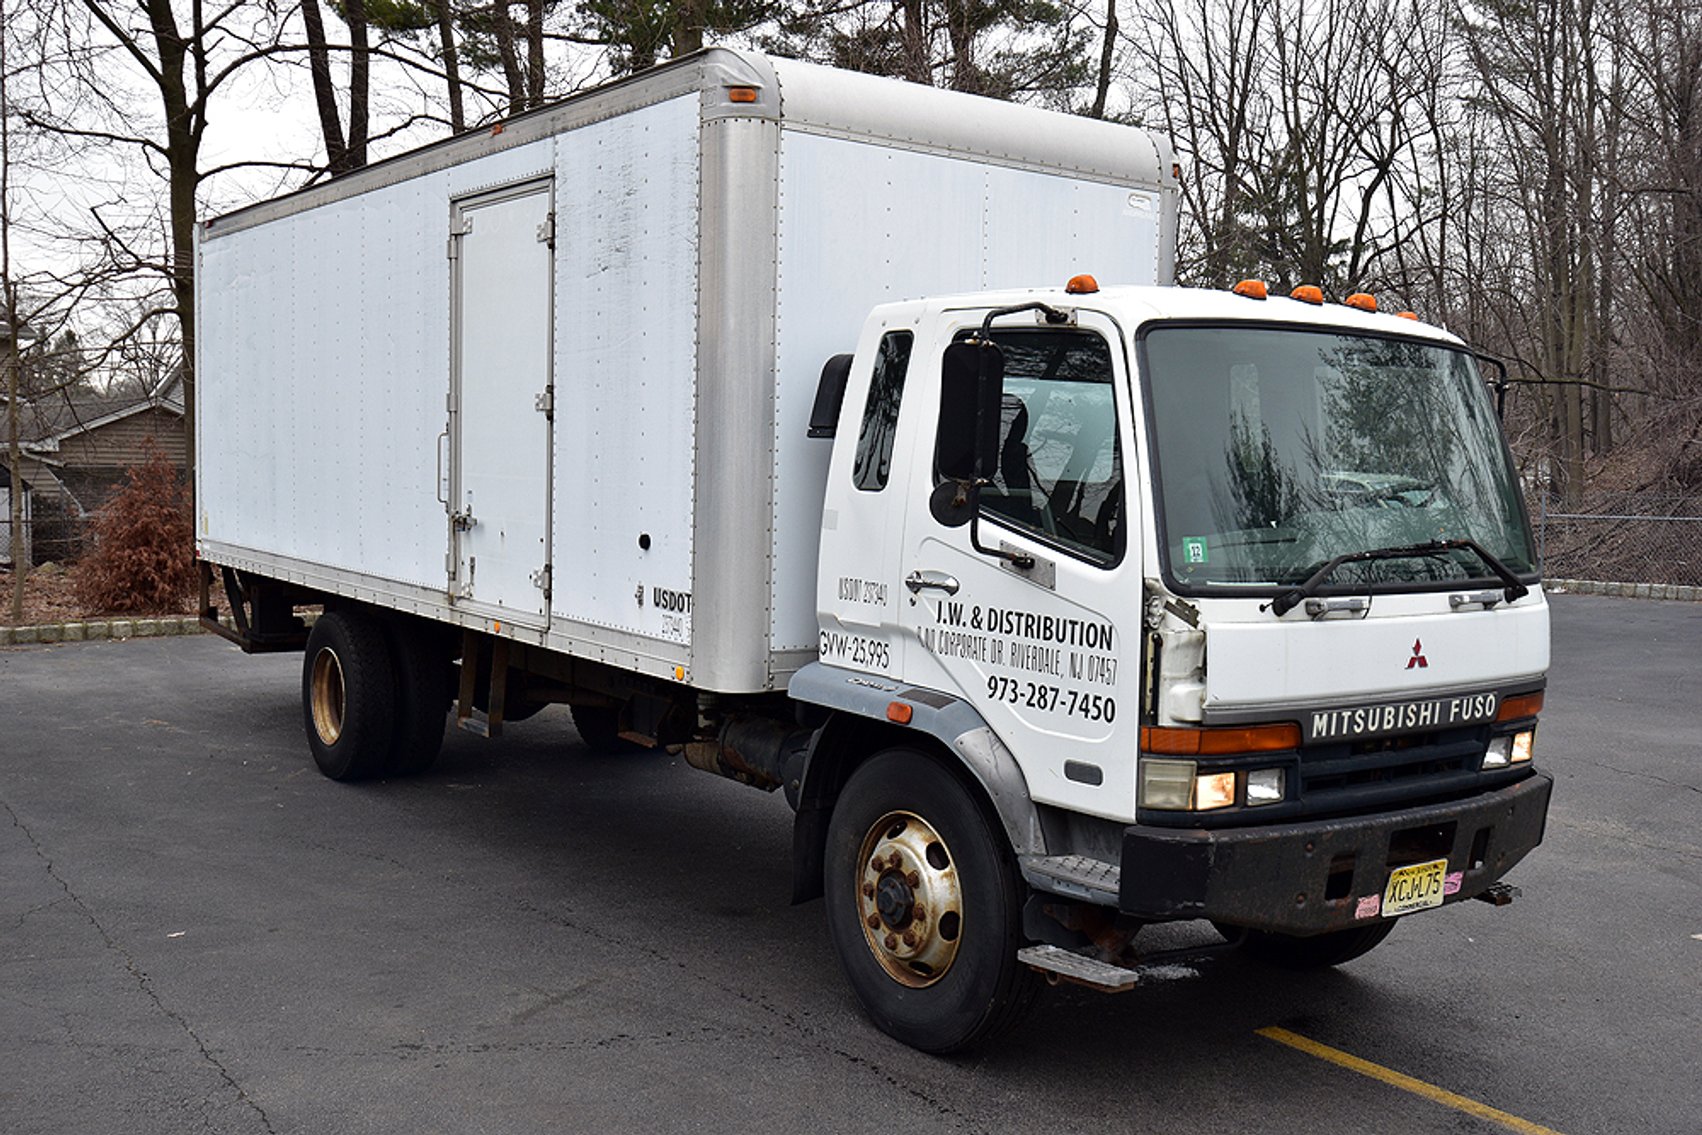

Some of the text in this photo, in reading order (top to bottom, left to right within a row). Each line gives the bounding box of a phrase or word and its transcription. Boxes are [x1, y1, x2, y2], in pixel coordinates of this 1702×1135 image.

[653, 586, 692, 614] USDOT
[820, 630, 889, 668] GVW-25,995
[936, 600, 1113, 651] J.W. & DISTRIBUTION
[938, 630, 987, 662] CORPORATE
[990, 638, 1006, 667] DR.
[1010, 641, 1065, 679] RIVERDALE,
[1069, 652, 1084, 680] NJ
[1087, 654, 1118, 686] 07457
[987, 675, 1116, 724] 973-287-7450
[1311, 694, 1497, 739] MITSUBISHI FUSO
